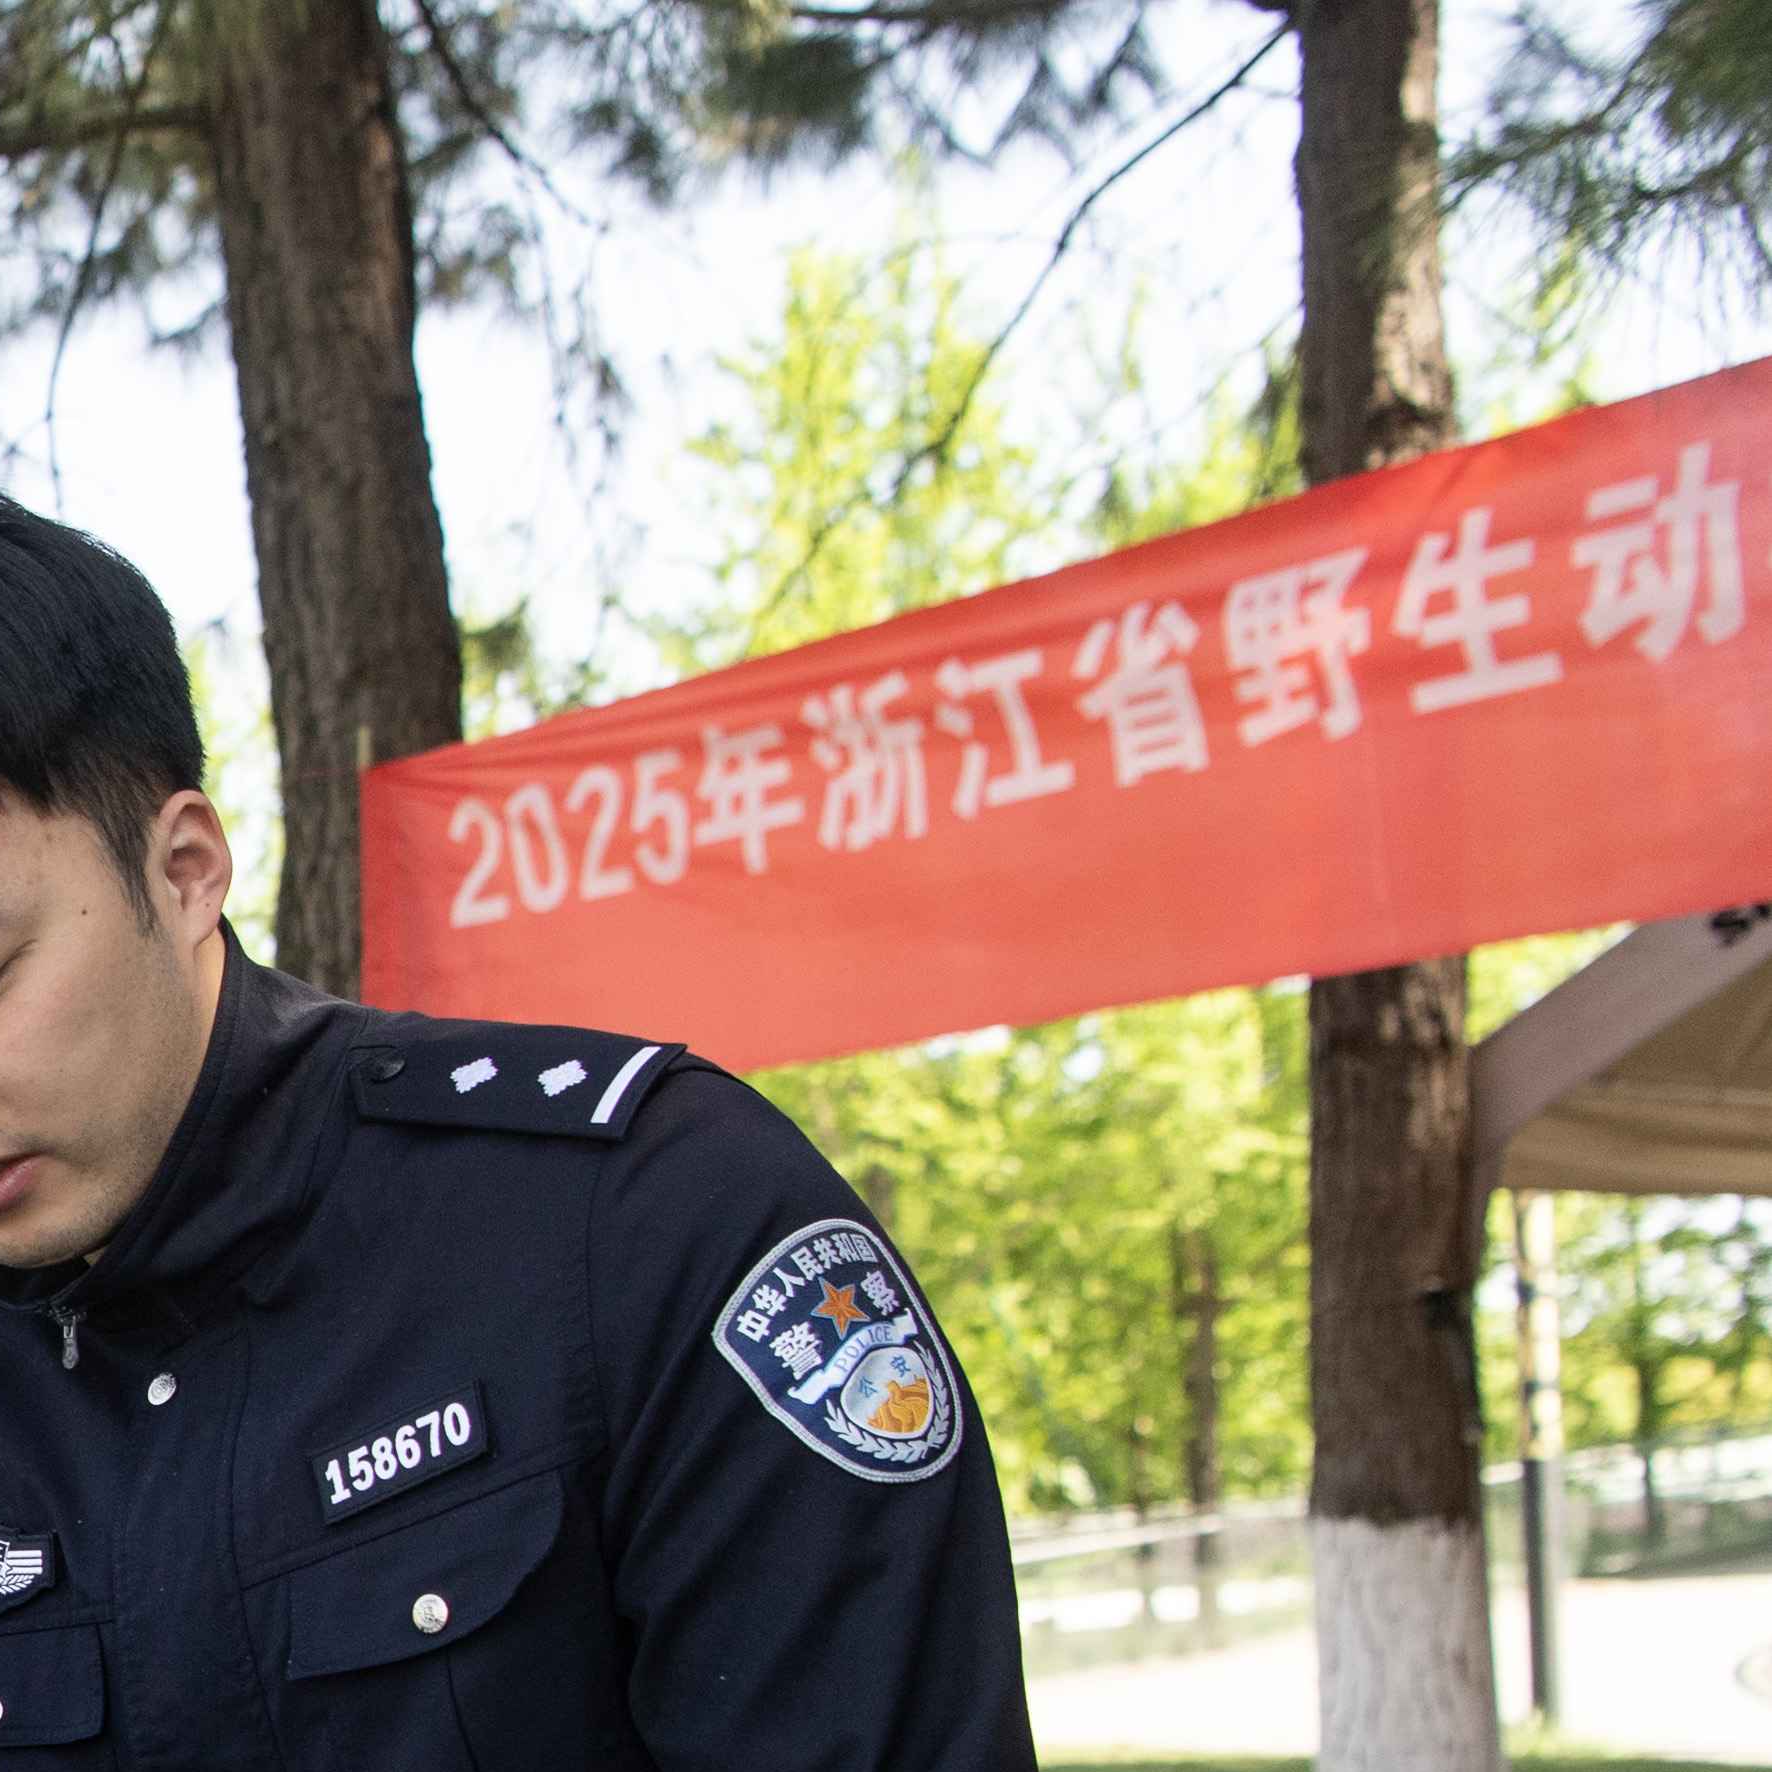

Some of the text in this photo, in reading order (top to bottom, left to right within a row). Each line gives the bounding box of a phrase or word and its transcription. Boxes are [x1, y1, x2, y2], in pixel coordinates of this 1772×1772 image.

[448, 440, 1746, 930] 2025年浙江省野生动
[736, 1232, 879, 1343] 中华人民共和国
[836, 1324, 893, 1373] POLICE
[324, 1402, 472, 1505] 158670
